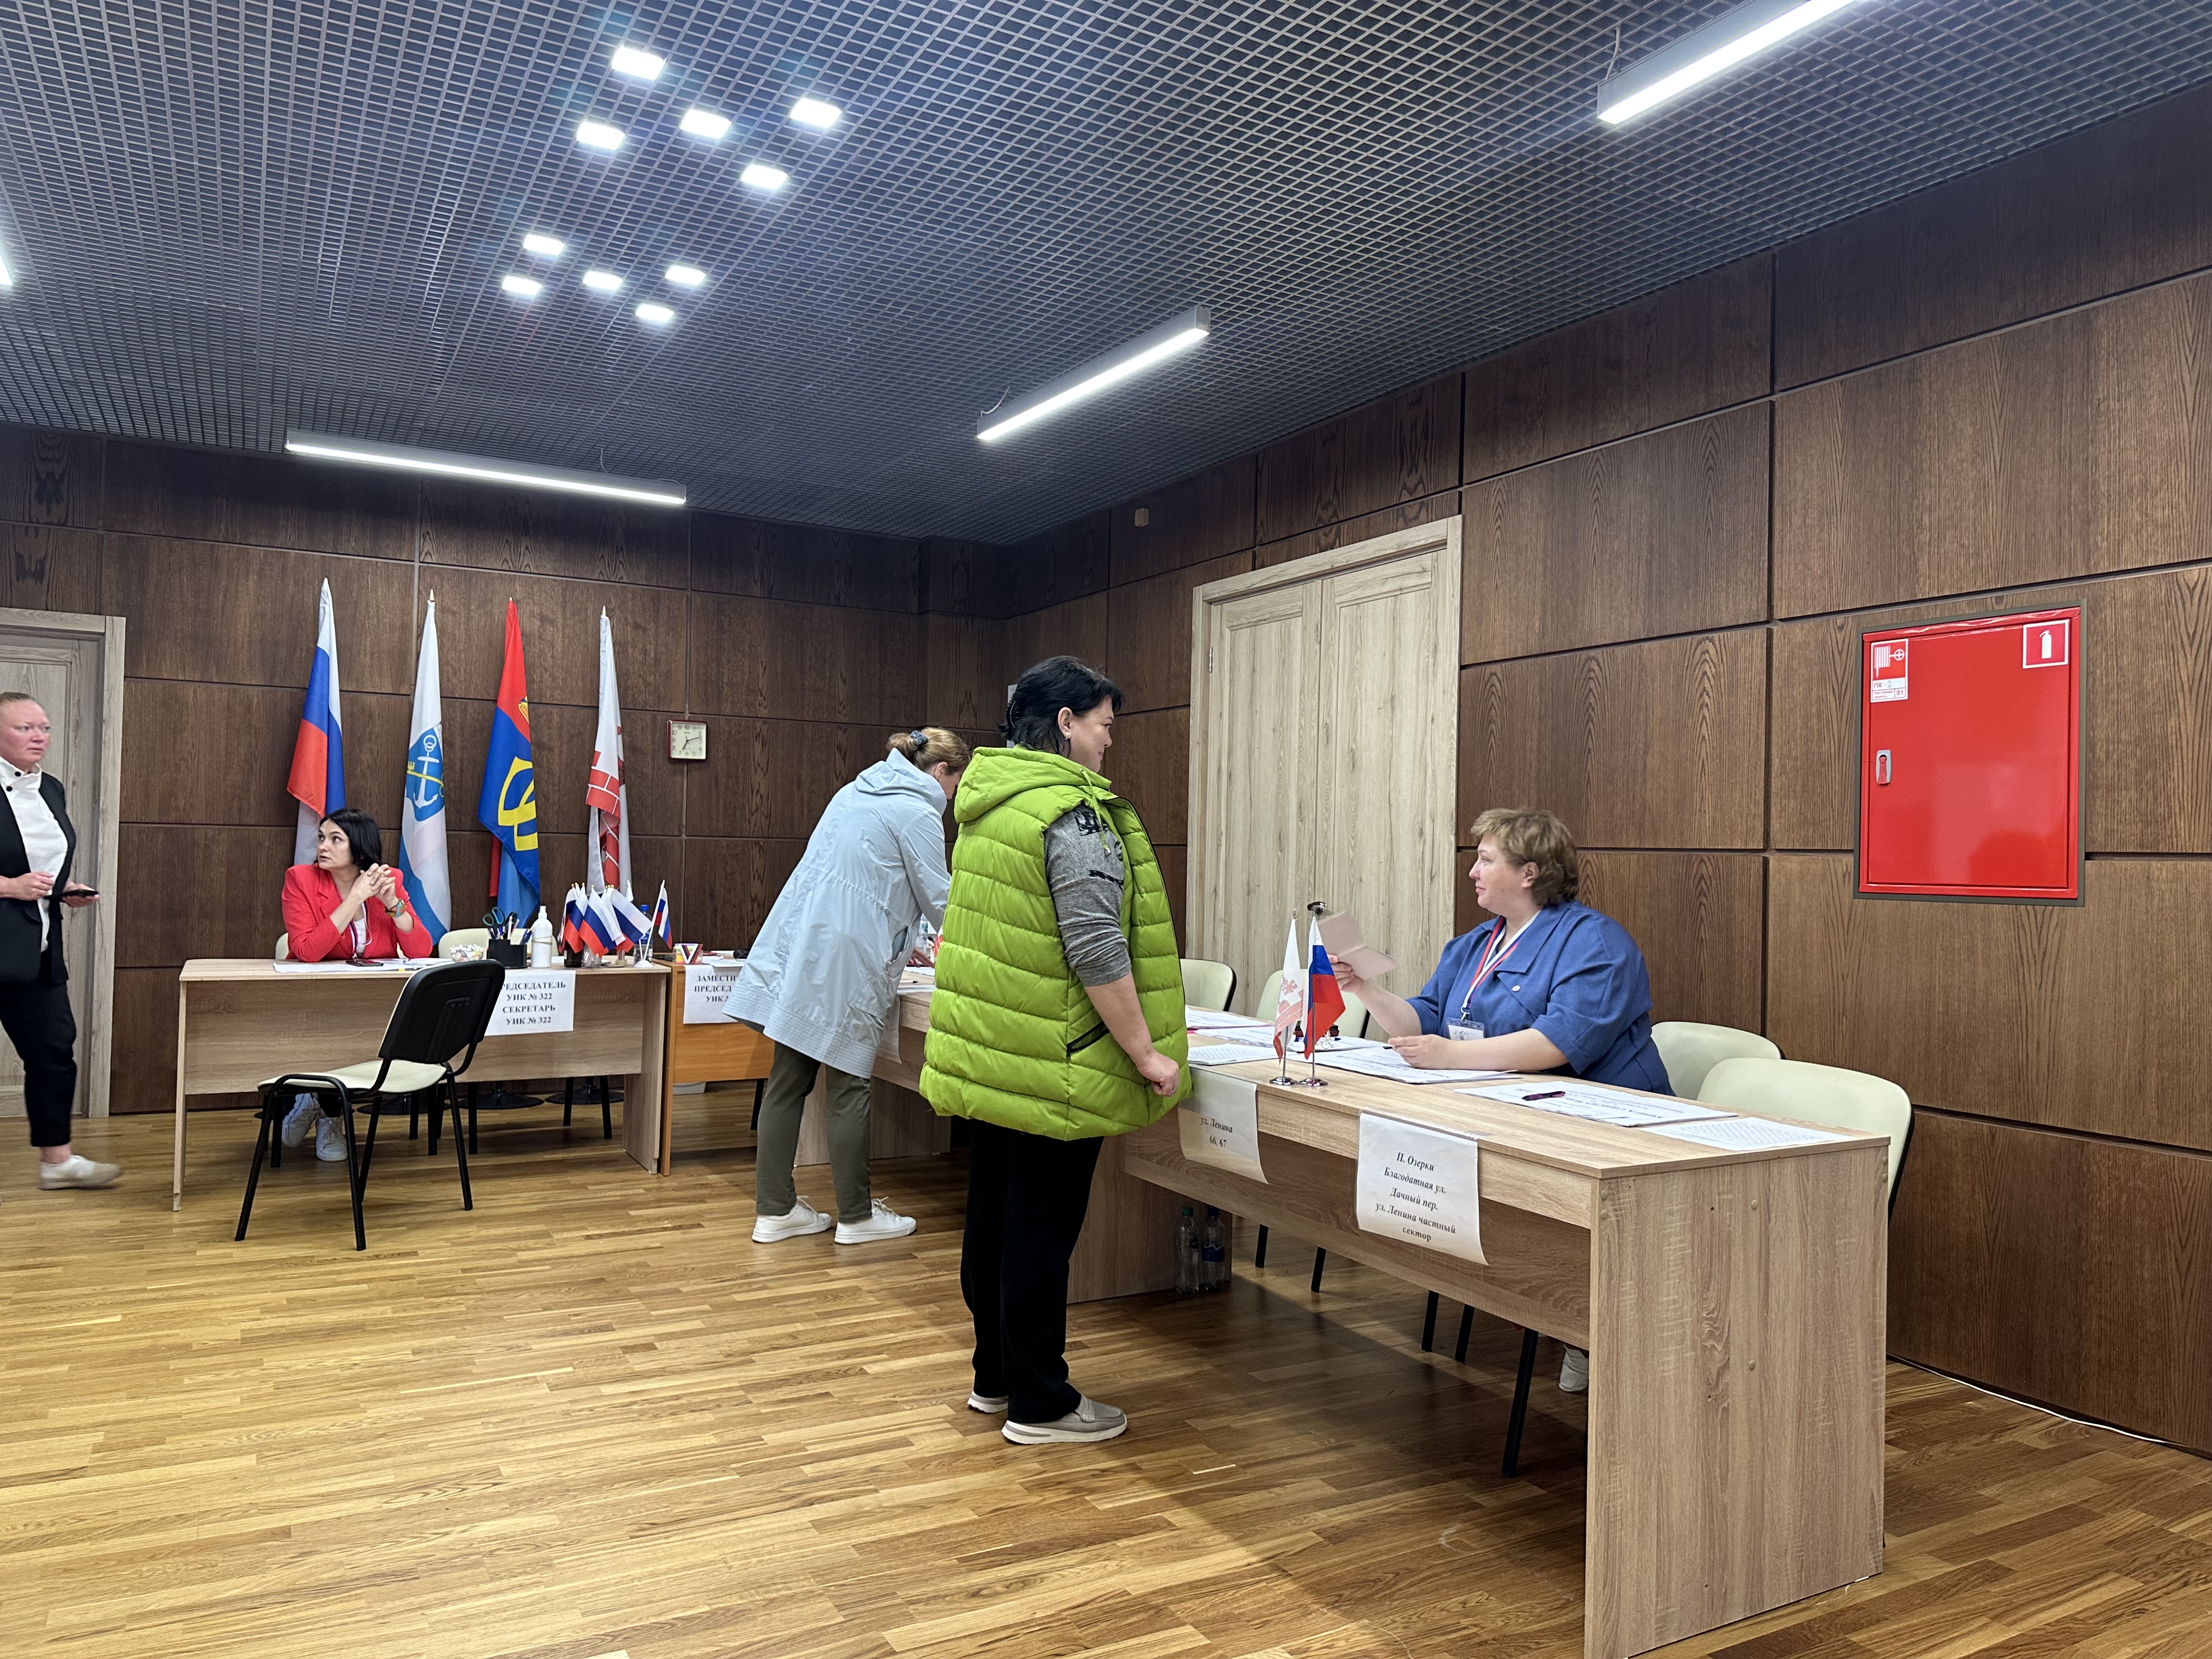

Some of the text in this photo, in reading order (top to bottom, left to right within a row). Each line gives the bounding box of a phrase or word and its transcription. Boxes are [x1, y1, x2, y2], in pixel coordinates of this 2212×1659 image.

[503, 1005, 556, 1013] СЕКРЕТАРЬ
[1200, 1117, 1233, 1133] ул. Ленина
[1209, 1135, 1227, 1148] 66, 67
[1396, 1152, 1434, 1171] П. Озерки
[1384, 1166, 1446, 1194] Благодатная ул.
[1389, 1187, 1438, 1211] Дачный пер.
[1375, 1203, 1455, 1234] ул. Ленина частный
[1402, 1227, 1431, 1242] сектор
